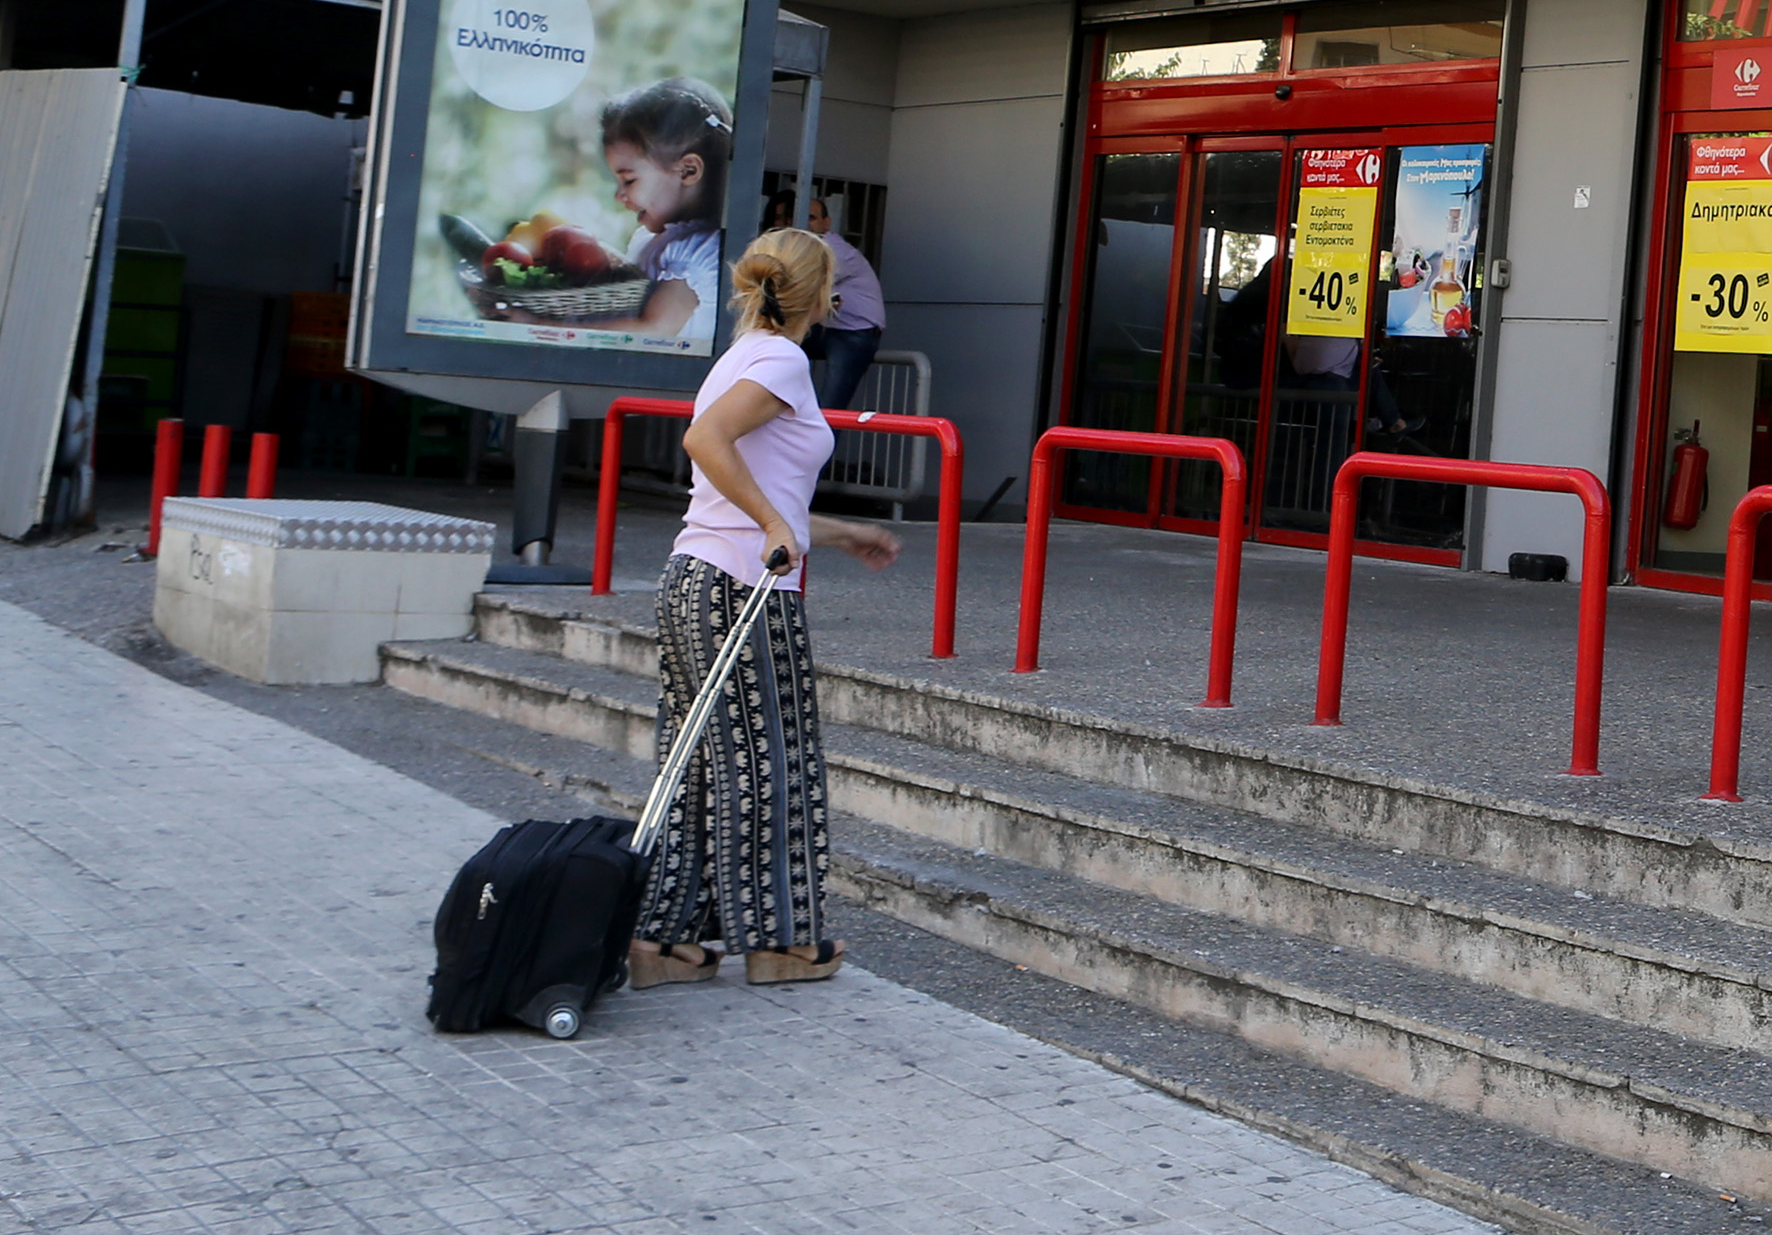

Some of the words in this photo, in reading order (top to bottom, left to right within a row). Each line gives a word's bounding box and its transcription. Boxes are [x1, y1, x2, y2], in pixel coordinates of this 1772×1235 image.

[493, 8, 549, 33] 100%
[456, 28, 586, 64] Ελληνικότητα
[1697, 145, 1747, 160] Φθηνότερα
[1694, 162, 1721, 175] κοντά
